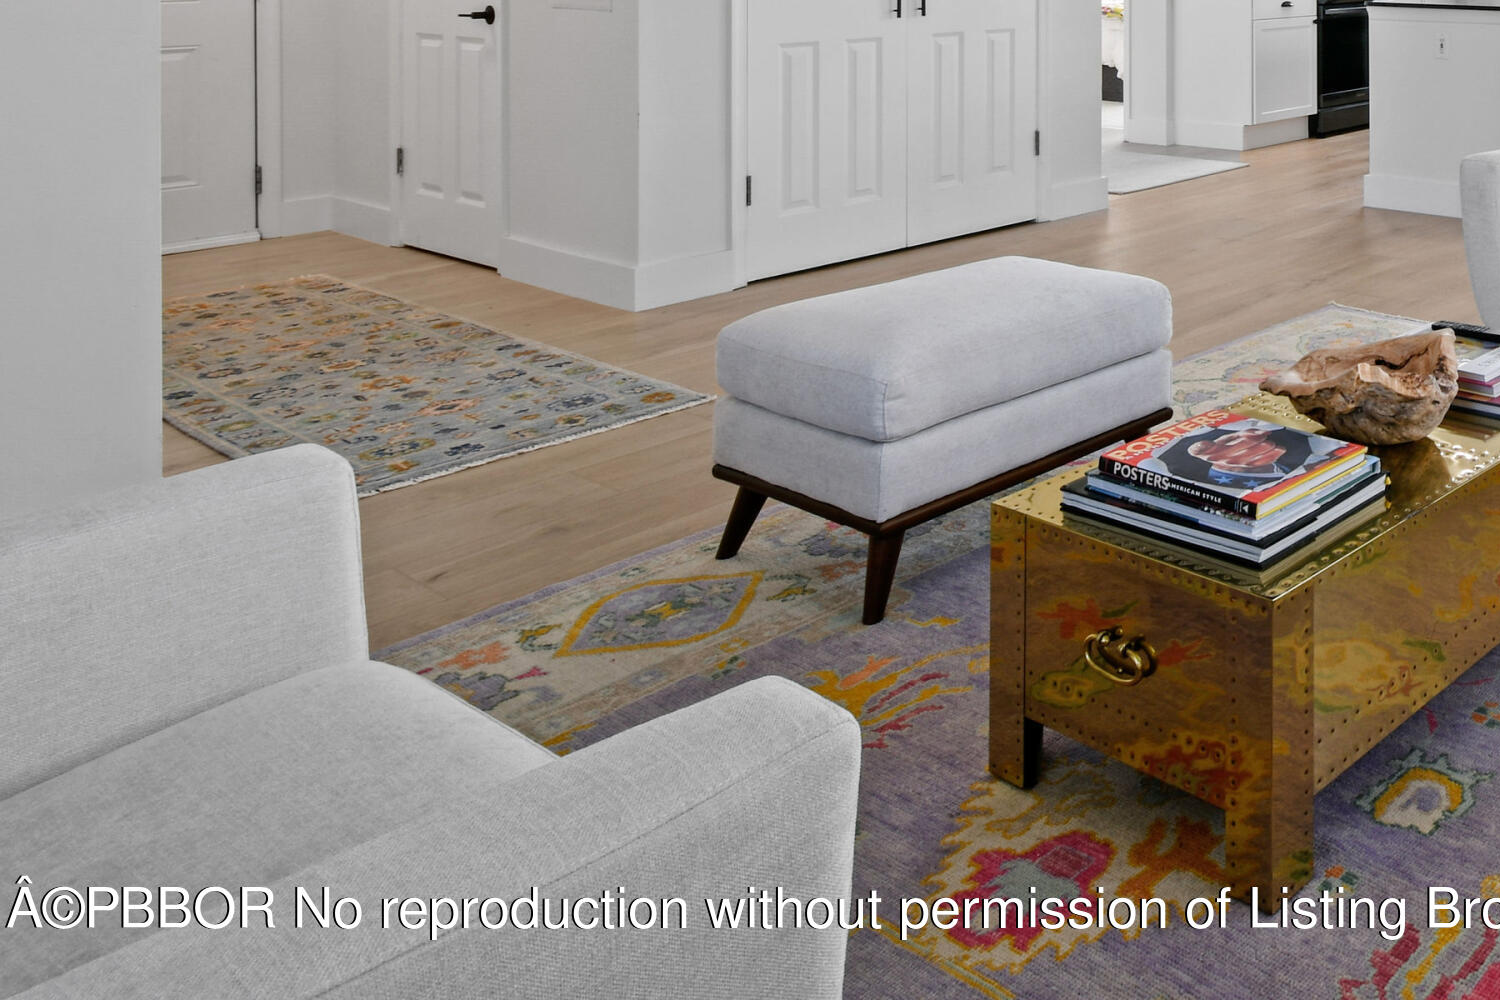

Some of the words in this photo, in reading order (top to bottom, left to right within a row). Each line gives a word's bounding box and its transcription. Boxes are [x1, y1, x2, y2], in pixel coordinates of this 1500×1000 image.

[1107, 409, 1231, 460] POSTERS
[1114, 462, 1170, 491] POSTERS
[1167, 482, 1201, 497] AMERICAN
[1202, 493, 1222, 504] STYLE
